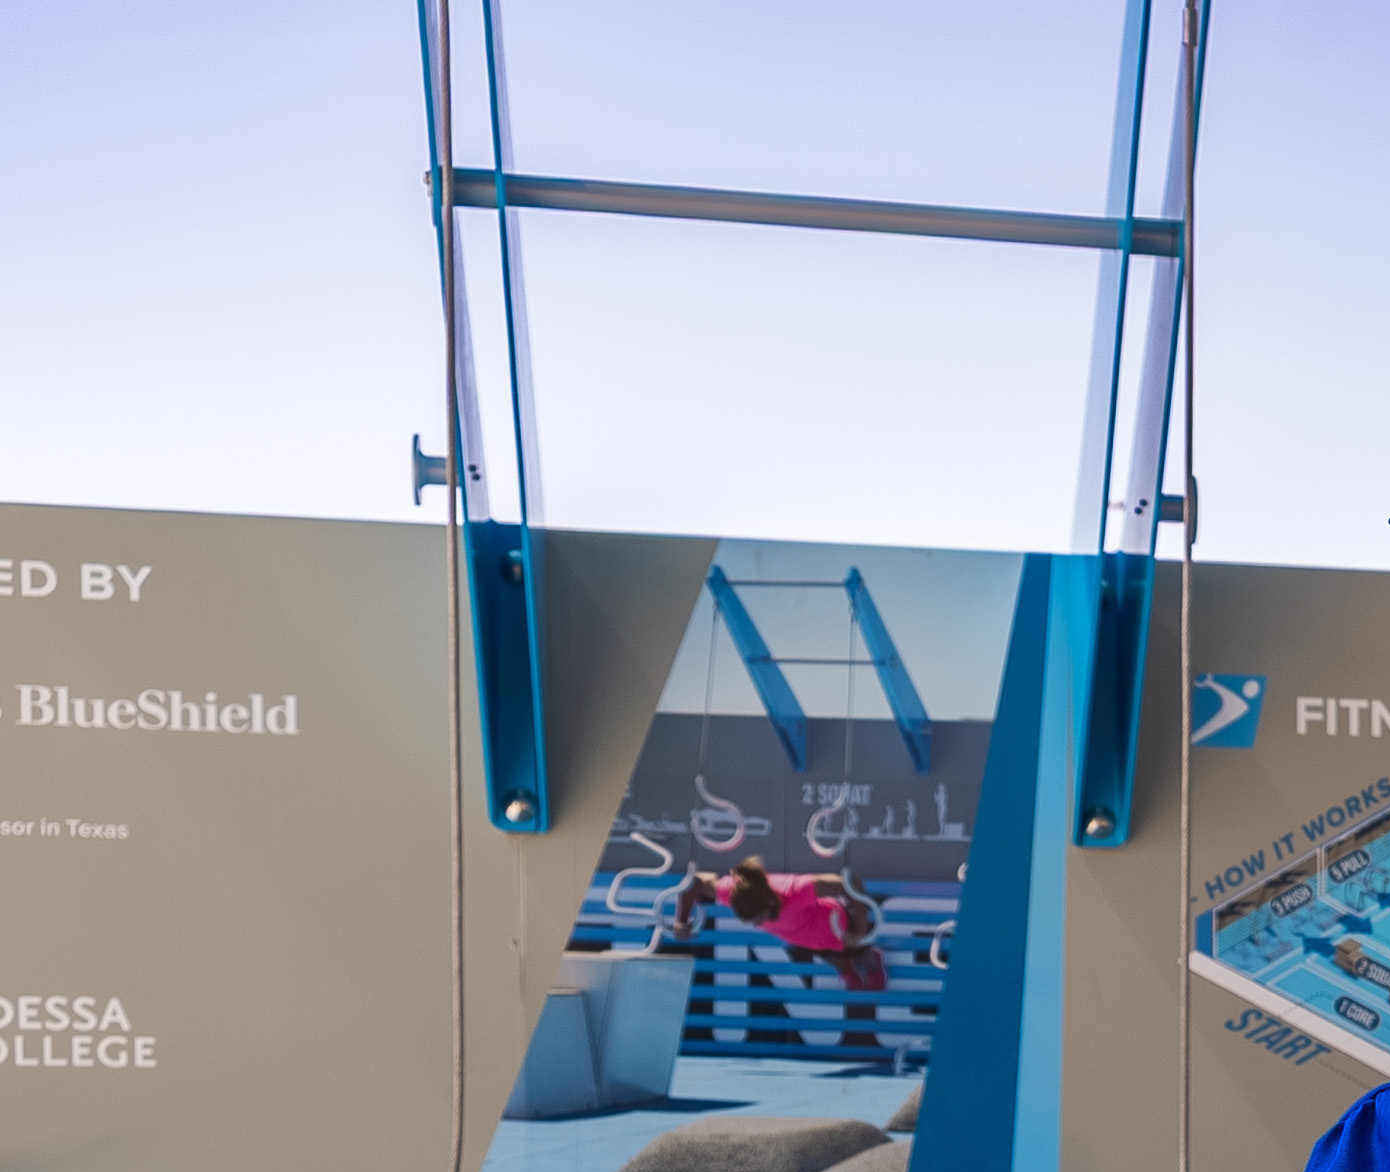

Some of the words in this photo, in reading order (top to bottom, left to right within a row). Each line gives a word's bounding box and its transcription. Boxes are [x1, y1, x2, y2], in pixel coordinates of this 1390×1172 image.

[80, 562, 153, 602] BY
[15, 683, 300, 736] BlueShield
[39, 818, 61, 838] in
[65, 818, 130, 839] Texas
[1204, 848, 1266, 900] HOW
[1272, 831, 1296, 861] IT
[1223, 1007, 1332, 1067] START
[1346, 1003, 1376, 1029] CORE
